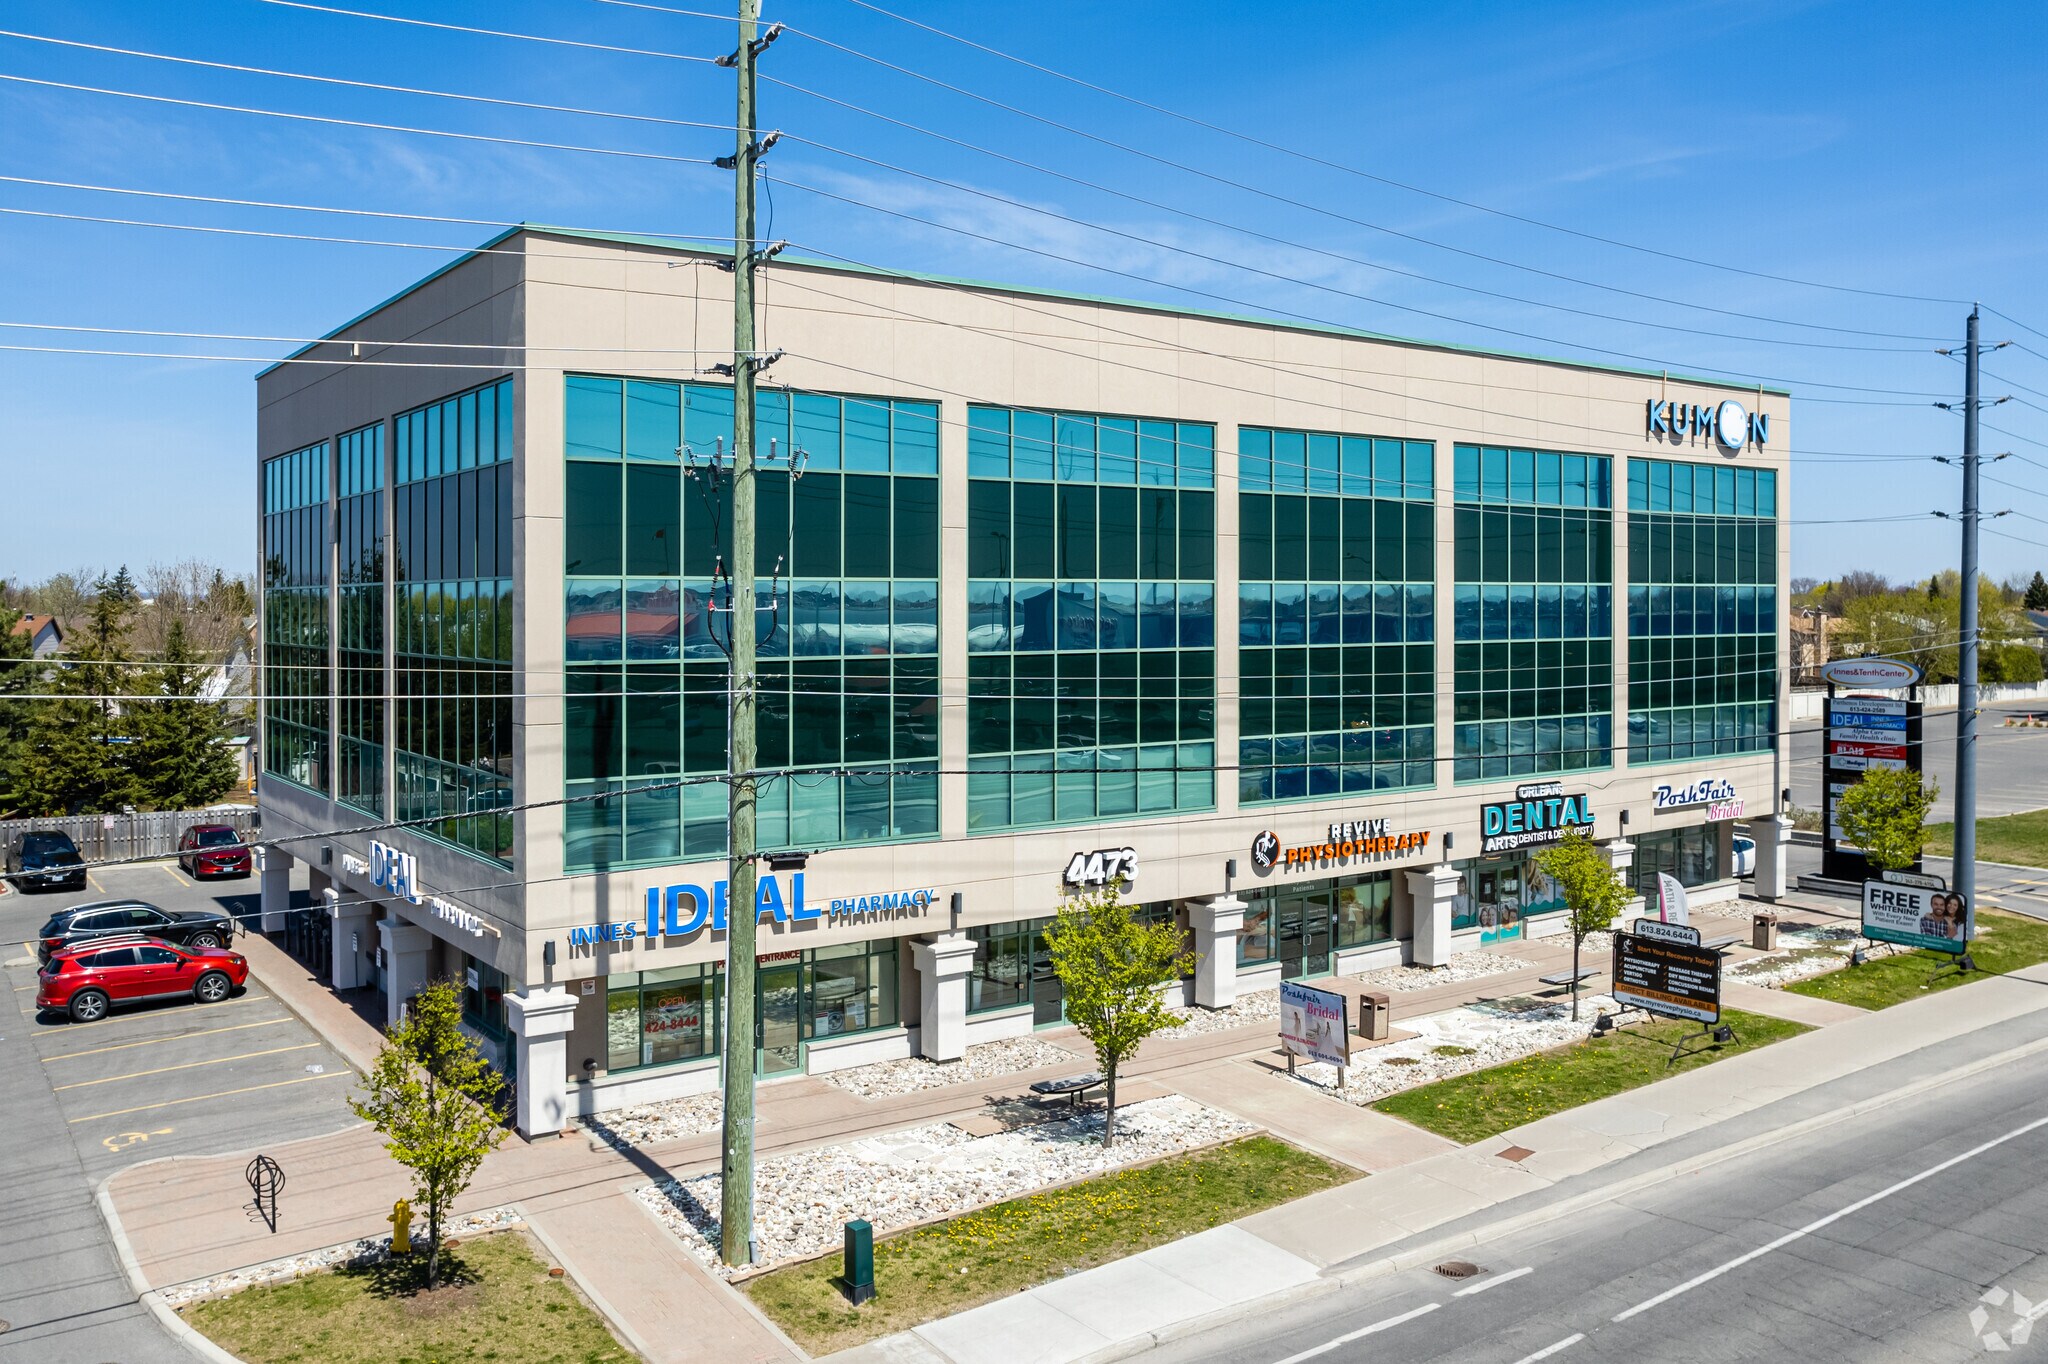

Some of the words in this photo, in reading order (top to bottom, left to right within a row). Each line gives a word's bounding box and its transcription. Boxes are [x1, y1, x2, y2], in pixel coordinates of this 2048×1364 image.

[1647, 399, 1769, 449] KUMON
[1519, 783, 1564, 798] ORLEANS
[1485, 796, 1595, 836] DENTAL
[1710, 801, 1744, 820] Bridal
[1331, 819, 1391, 839] REVIVE
[1548, 831, 1553, 840] &
[1286, 831, 1431, 865] PHYSIOTHERAPY
[369, 840, 423, 905] IDEAL
[1066, 850, 1139, 885] 4473
[1664, 881, 1675, 903] MATH
[1870, 888, 1920, 910] FREE
[570, 921, 638, 946] INNES
[829, 889, 934, 917] PHARMACY
[1870, 903, 1919, 917] WHITENING
[1886, 912, 1902, 921] Every
[1875, 916, 1894, 925] Patient
[1641, 925, 1693, 941] 613.824.6444
[760, 950, 801, 964] ENTRANCE
[1624, 957, 1660, 969] PHYSIOTHERAPY
[1637, 946, 1652, 954] Start
[1667, 951, 1693, 963] Recovery
[1695, 957, 1715, 967] Today!
[1624, 964, 1657, 975] ACUPUNCTURE
[1624, 970, 1643, 979] VERTIGO
[1668, 966, 1691, 976] MASSAGE
[1691, 971, 1713, 980] THERAPY
[1624, 976, 1648, 986] ORTHOTICS
[1668, 980, 1698, 991] CONCUSSION
[1699, 985, 1715, 994] REHAB
[1679, 975, 1702, 984] NEEDLING
[1621, 985, 1644, 995] DIRECT
[1647, 990, 1672, 1002] BILLING
[1674, 996, 1712, 1011] AVAILABLE
[1668, 986, 1689, 995] BRACING
[1307, 1002, 1339, 1021] Bridal
[1630, 996, 1702, 1017] www.myrevivephysio.ca
[645, 1016, 699, 1034] 424-8444
